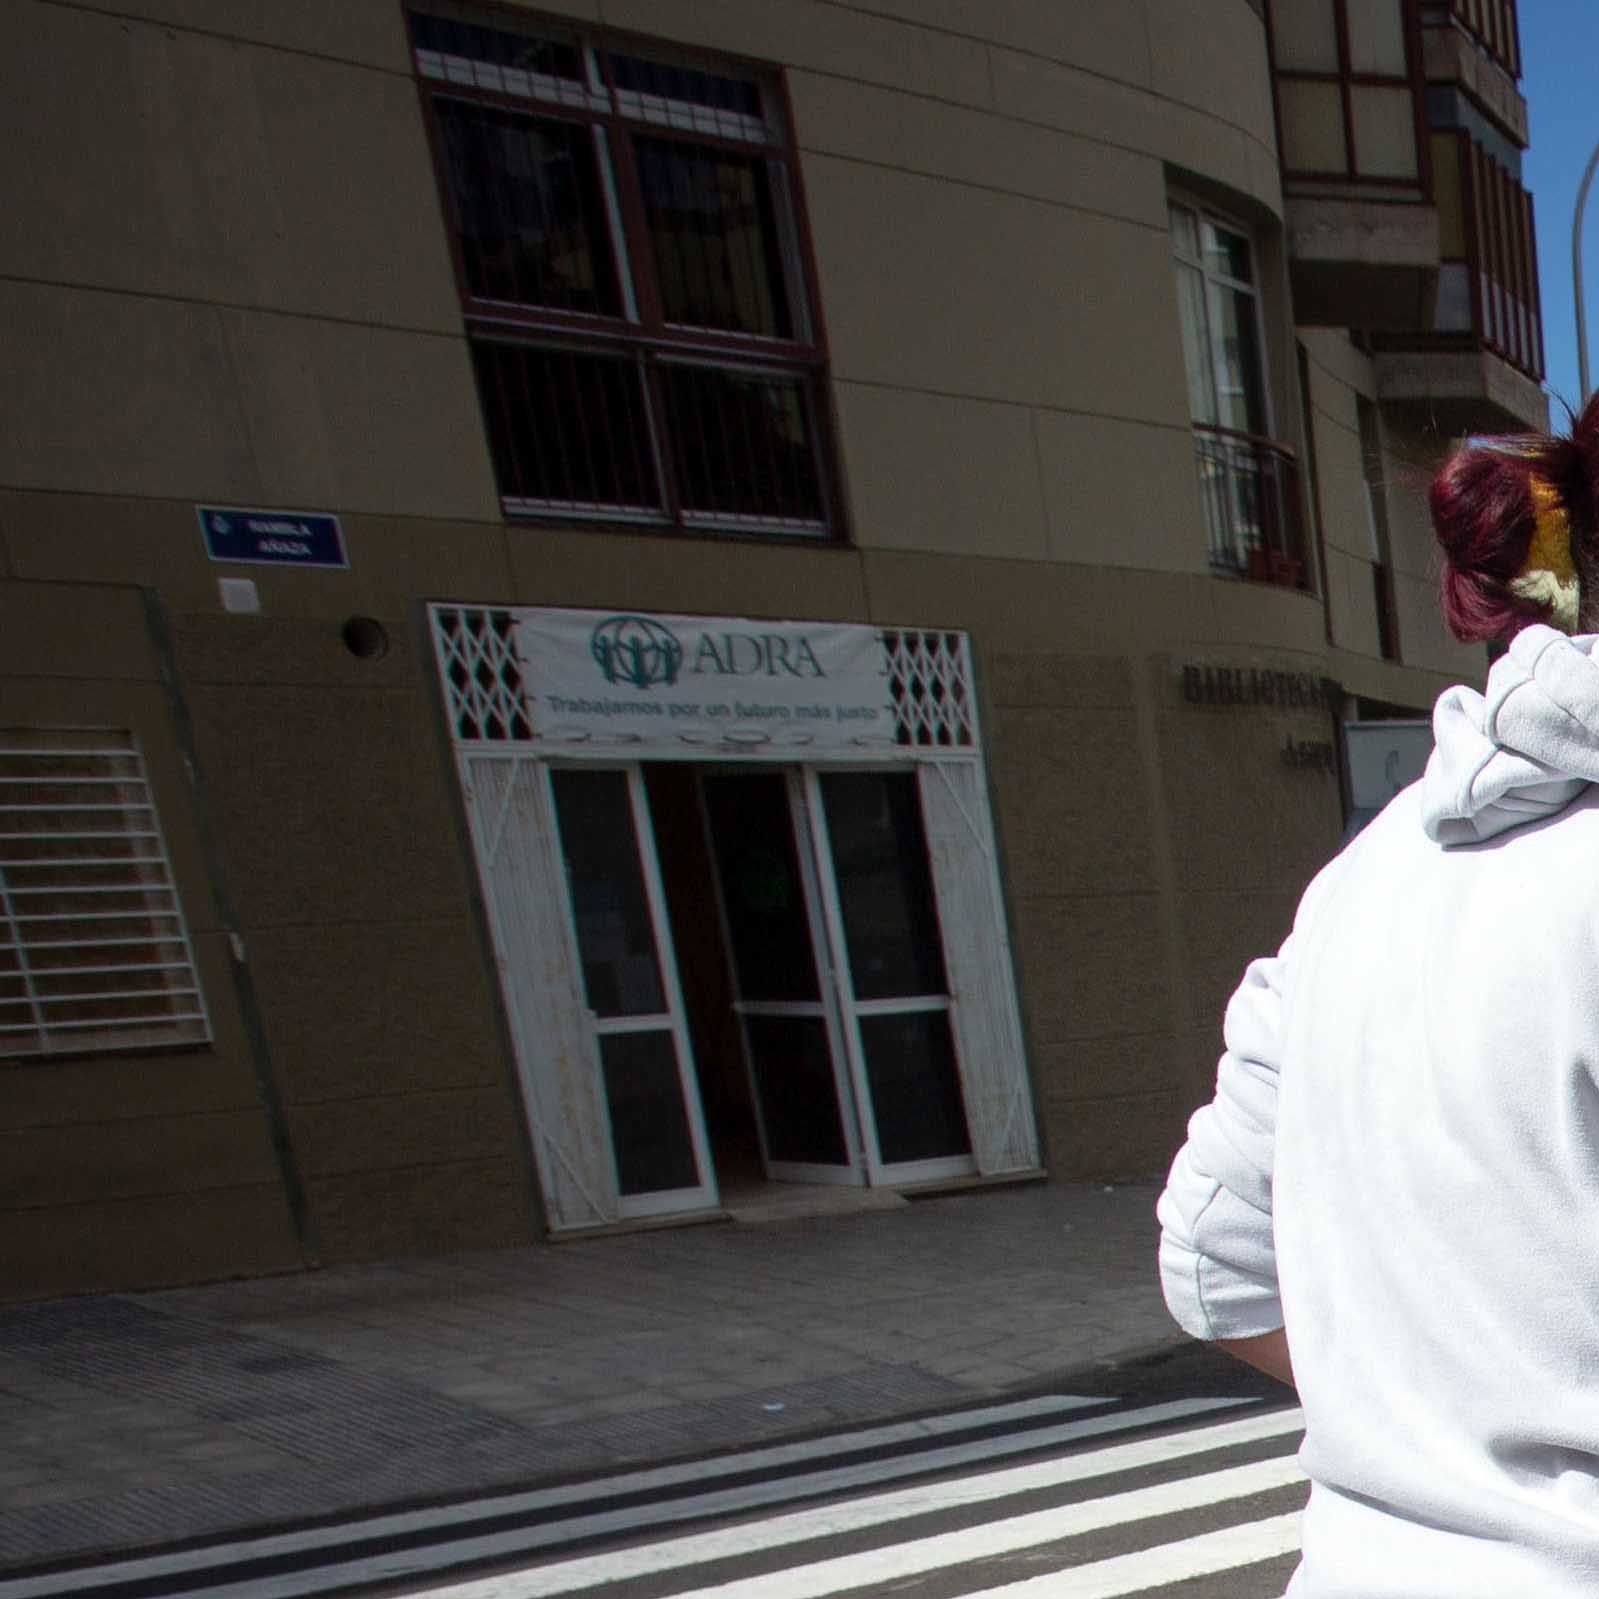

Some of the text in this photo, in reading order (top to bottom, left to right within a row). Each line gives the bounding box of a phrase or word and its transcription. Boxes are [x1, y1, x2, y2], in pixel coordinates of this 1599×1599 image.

[693, 631, 827, 678] ADRA
[545, 696, 878, 722] Trabajamos por un futuro más justo
